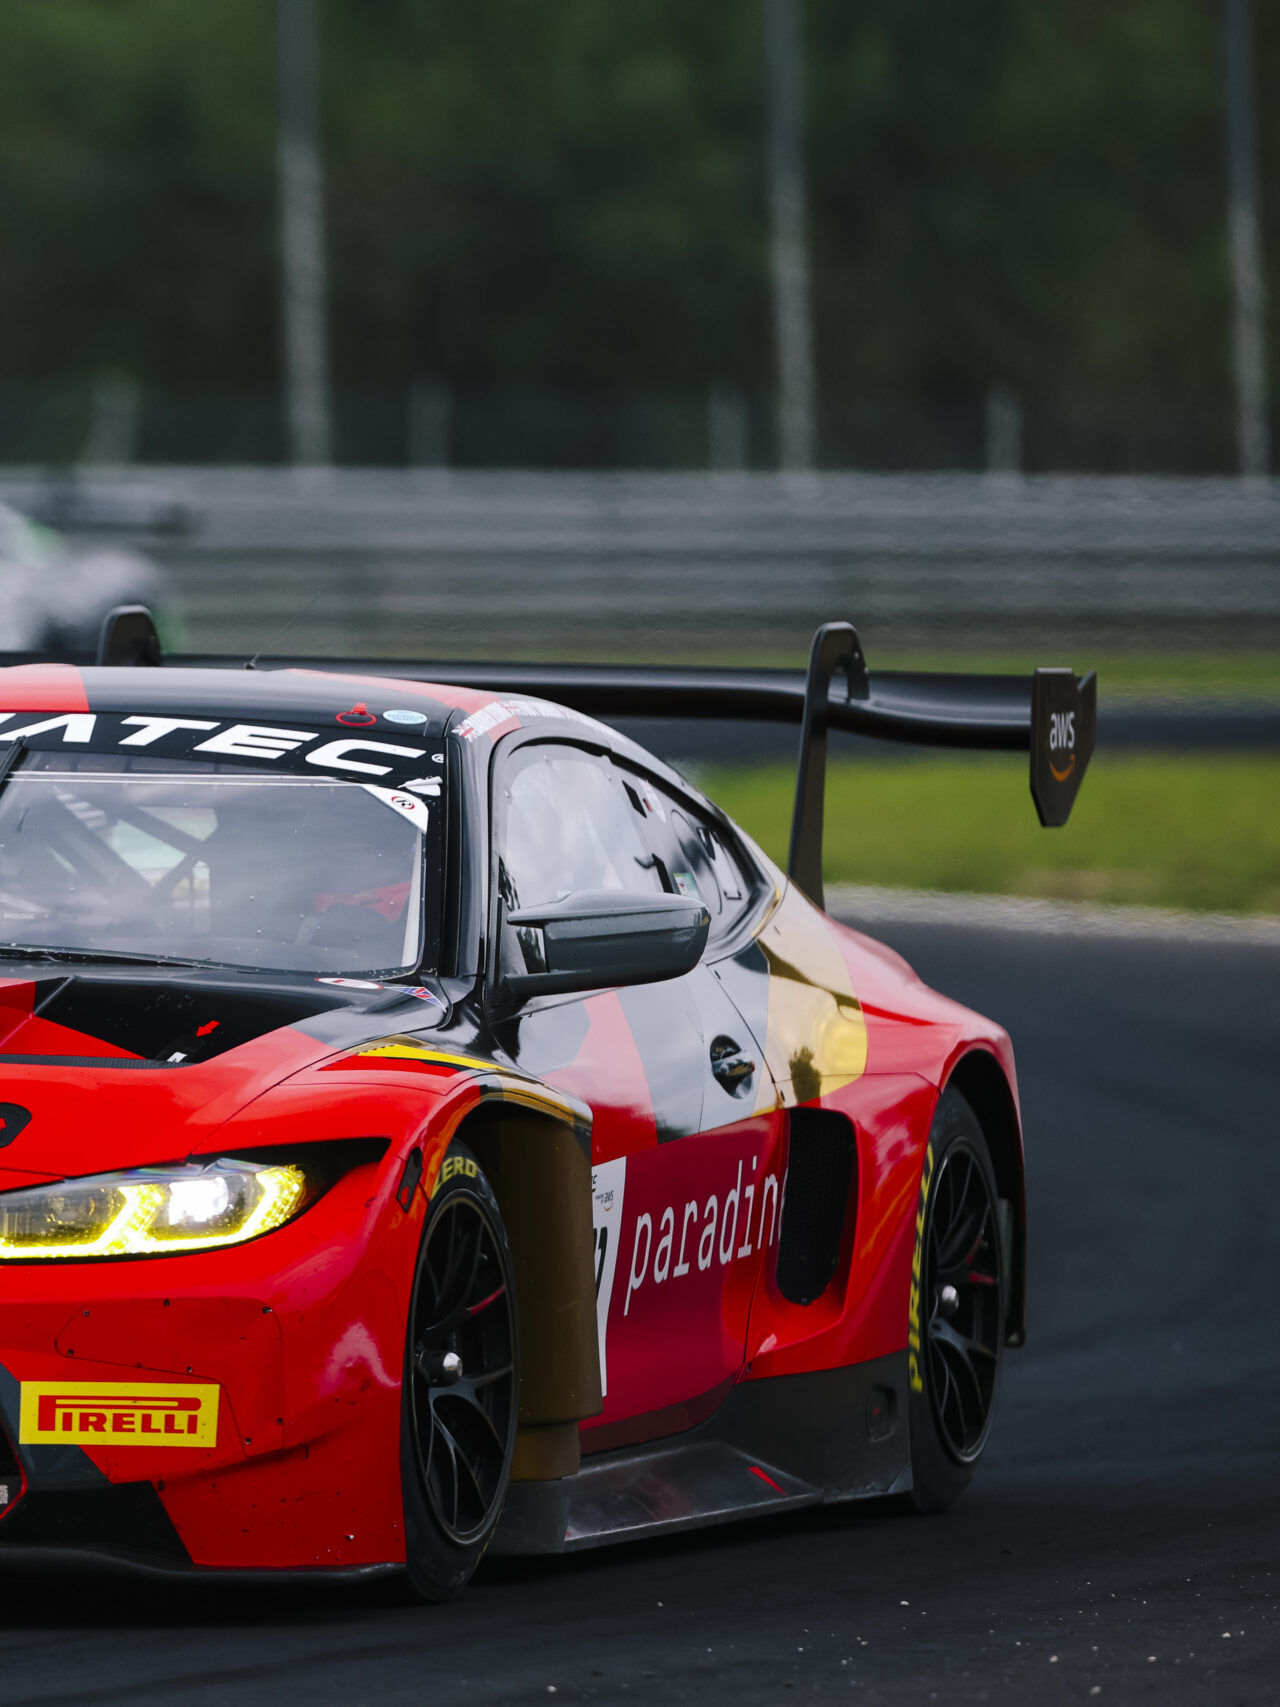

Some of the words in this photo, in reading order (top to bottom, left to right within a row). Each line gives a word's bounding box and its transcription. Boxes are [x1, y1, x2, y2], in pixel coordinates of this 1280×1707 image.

[1049, 711, 1075, 750] aws
[624, 1155, 788, 1316] paradin
[37, 1395, 202, 1434] PIRELLI
